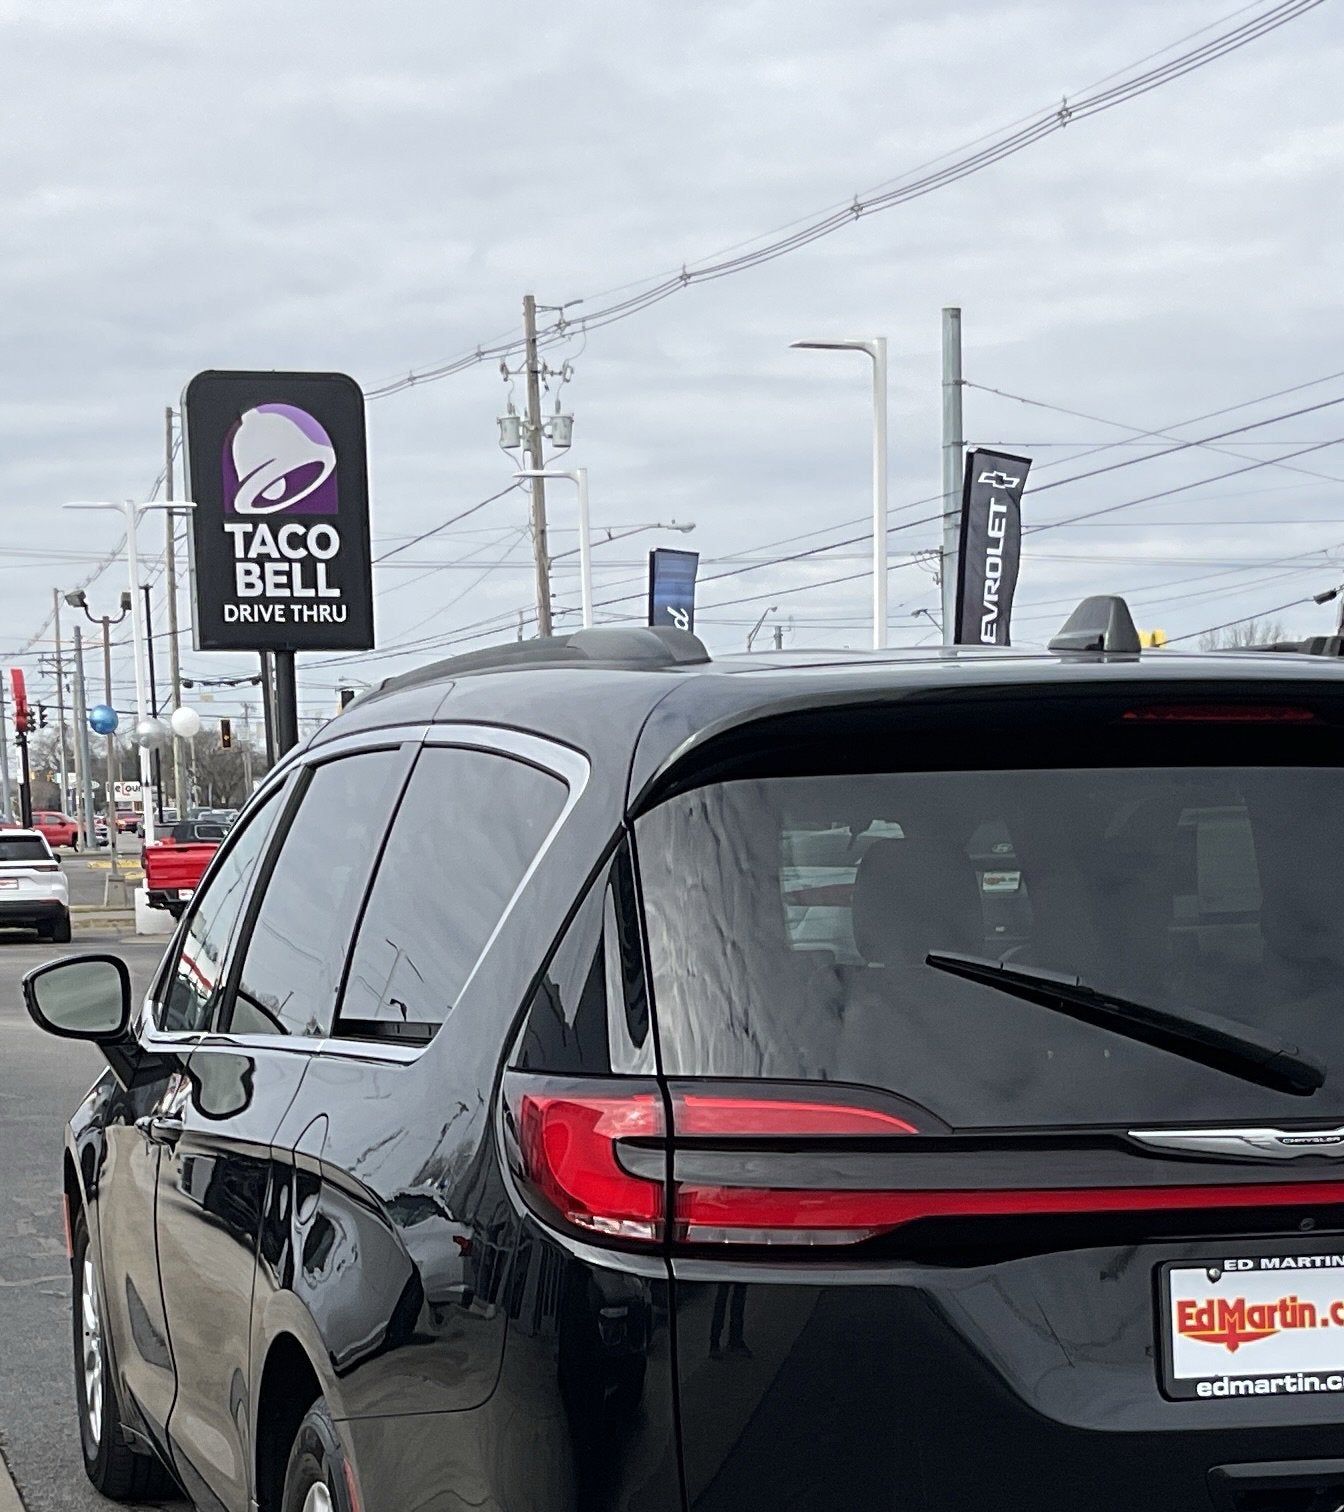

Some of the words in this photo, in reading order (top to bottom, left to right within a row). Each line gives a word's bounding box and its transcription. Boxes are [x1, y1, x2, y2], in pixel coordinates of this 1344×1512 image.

[223, 523, 340, 560] TACO
[236, 562, 341, 598] BELL
[981, 497, 1008, 644] EVROLET
[223, 604, 286, 623] DRIVE
[292, 604, 347, 623] THRU
[1223, 1259, 1254, 1271] ED
